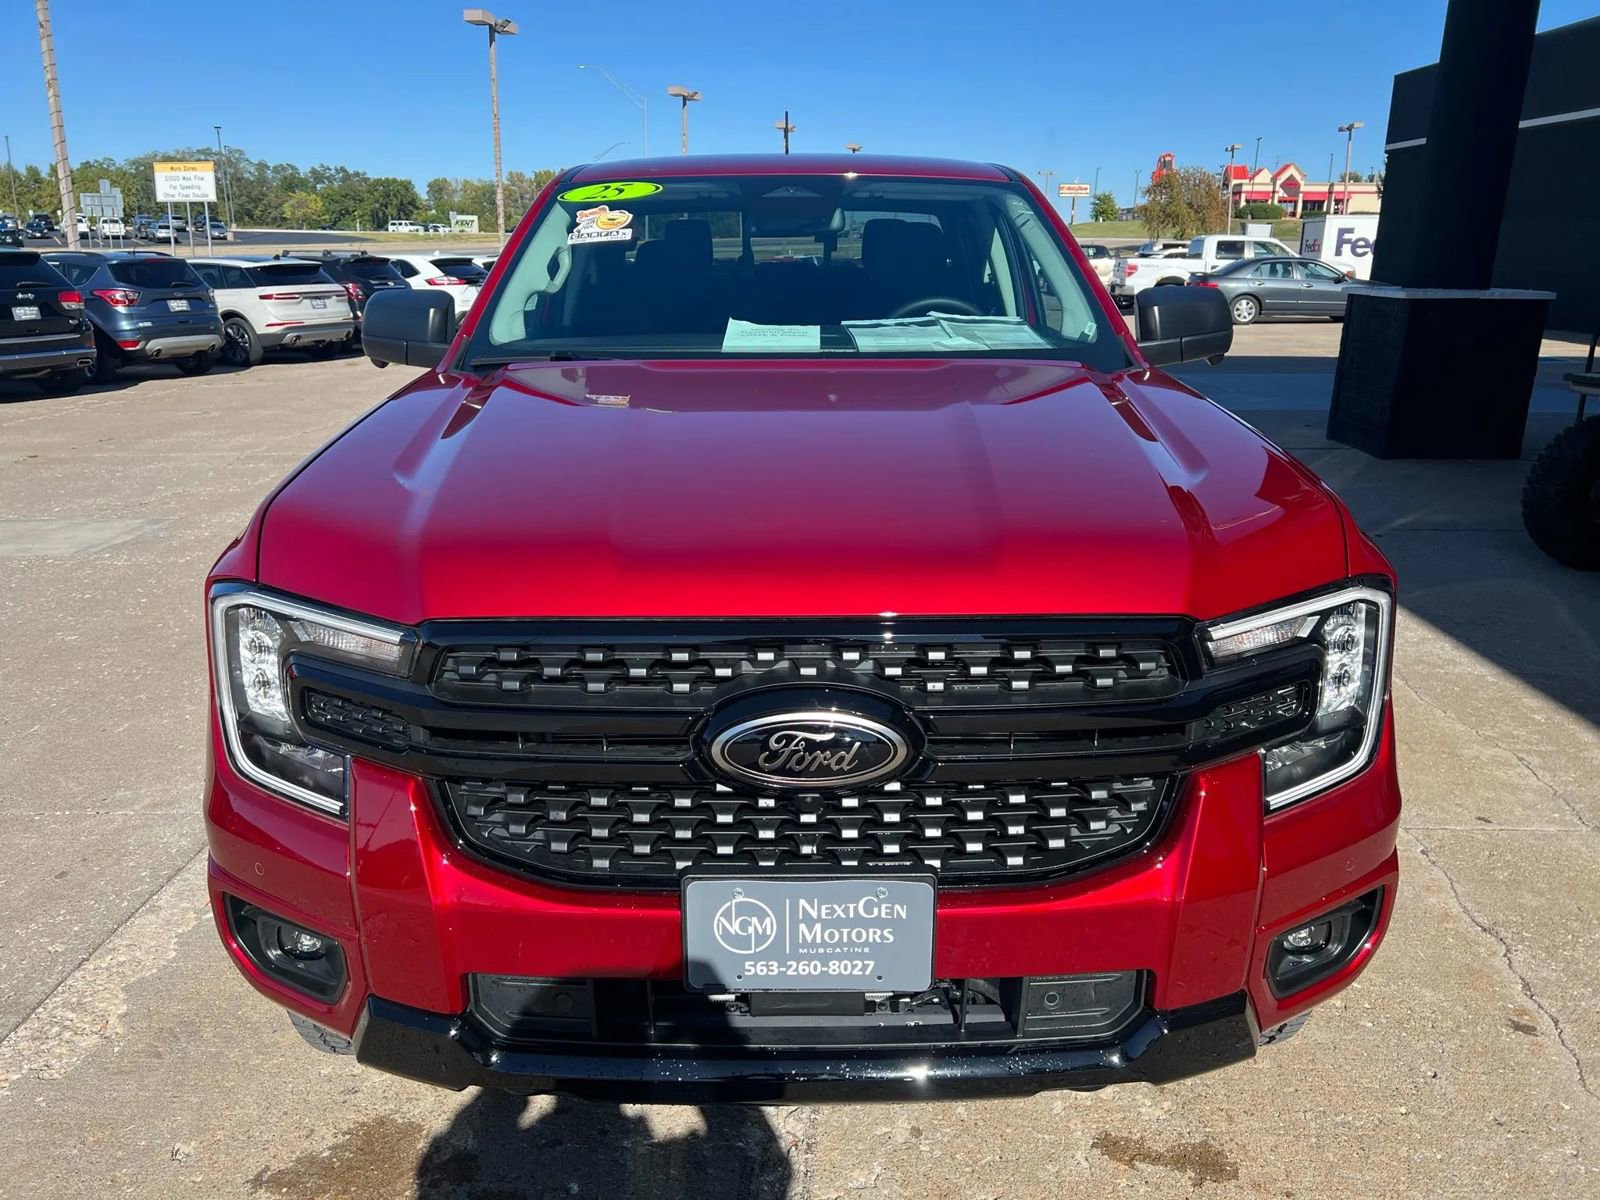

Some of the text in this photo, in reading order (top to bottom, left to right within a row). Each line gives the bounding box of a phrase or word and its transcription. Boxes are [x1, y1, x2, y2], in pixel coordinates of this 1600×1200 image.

[584, 183, 634, 199] 25
[570, 230, 628, 240] CARFAX
[1335, 227, 1376, 258] Fe
[758, 730, 861, 772] Ford
[744, 960, 875, 976] 563-260-8027
